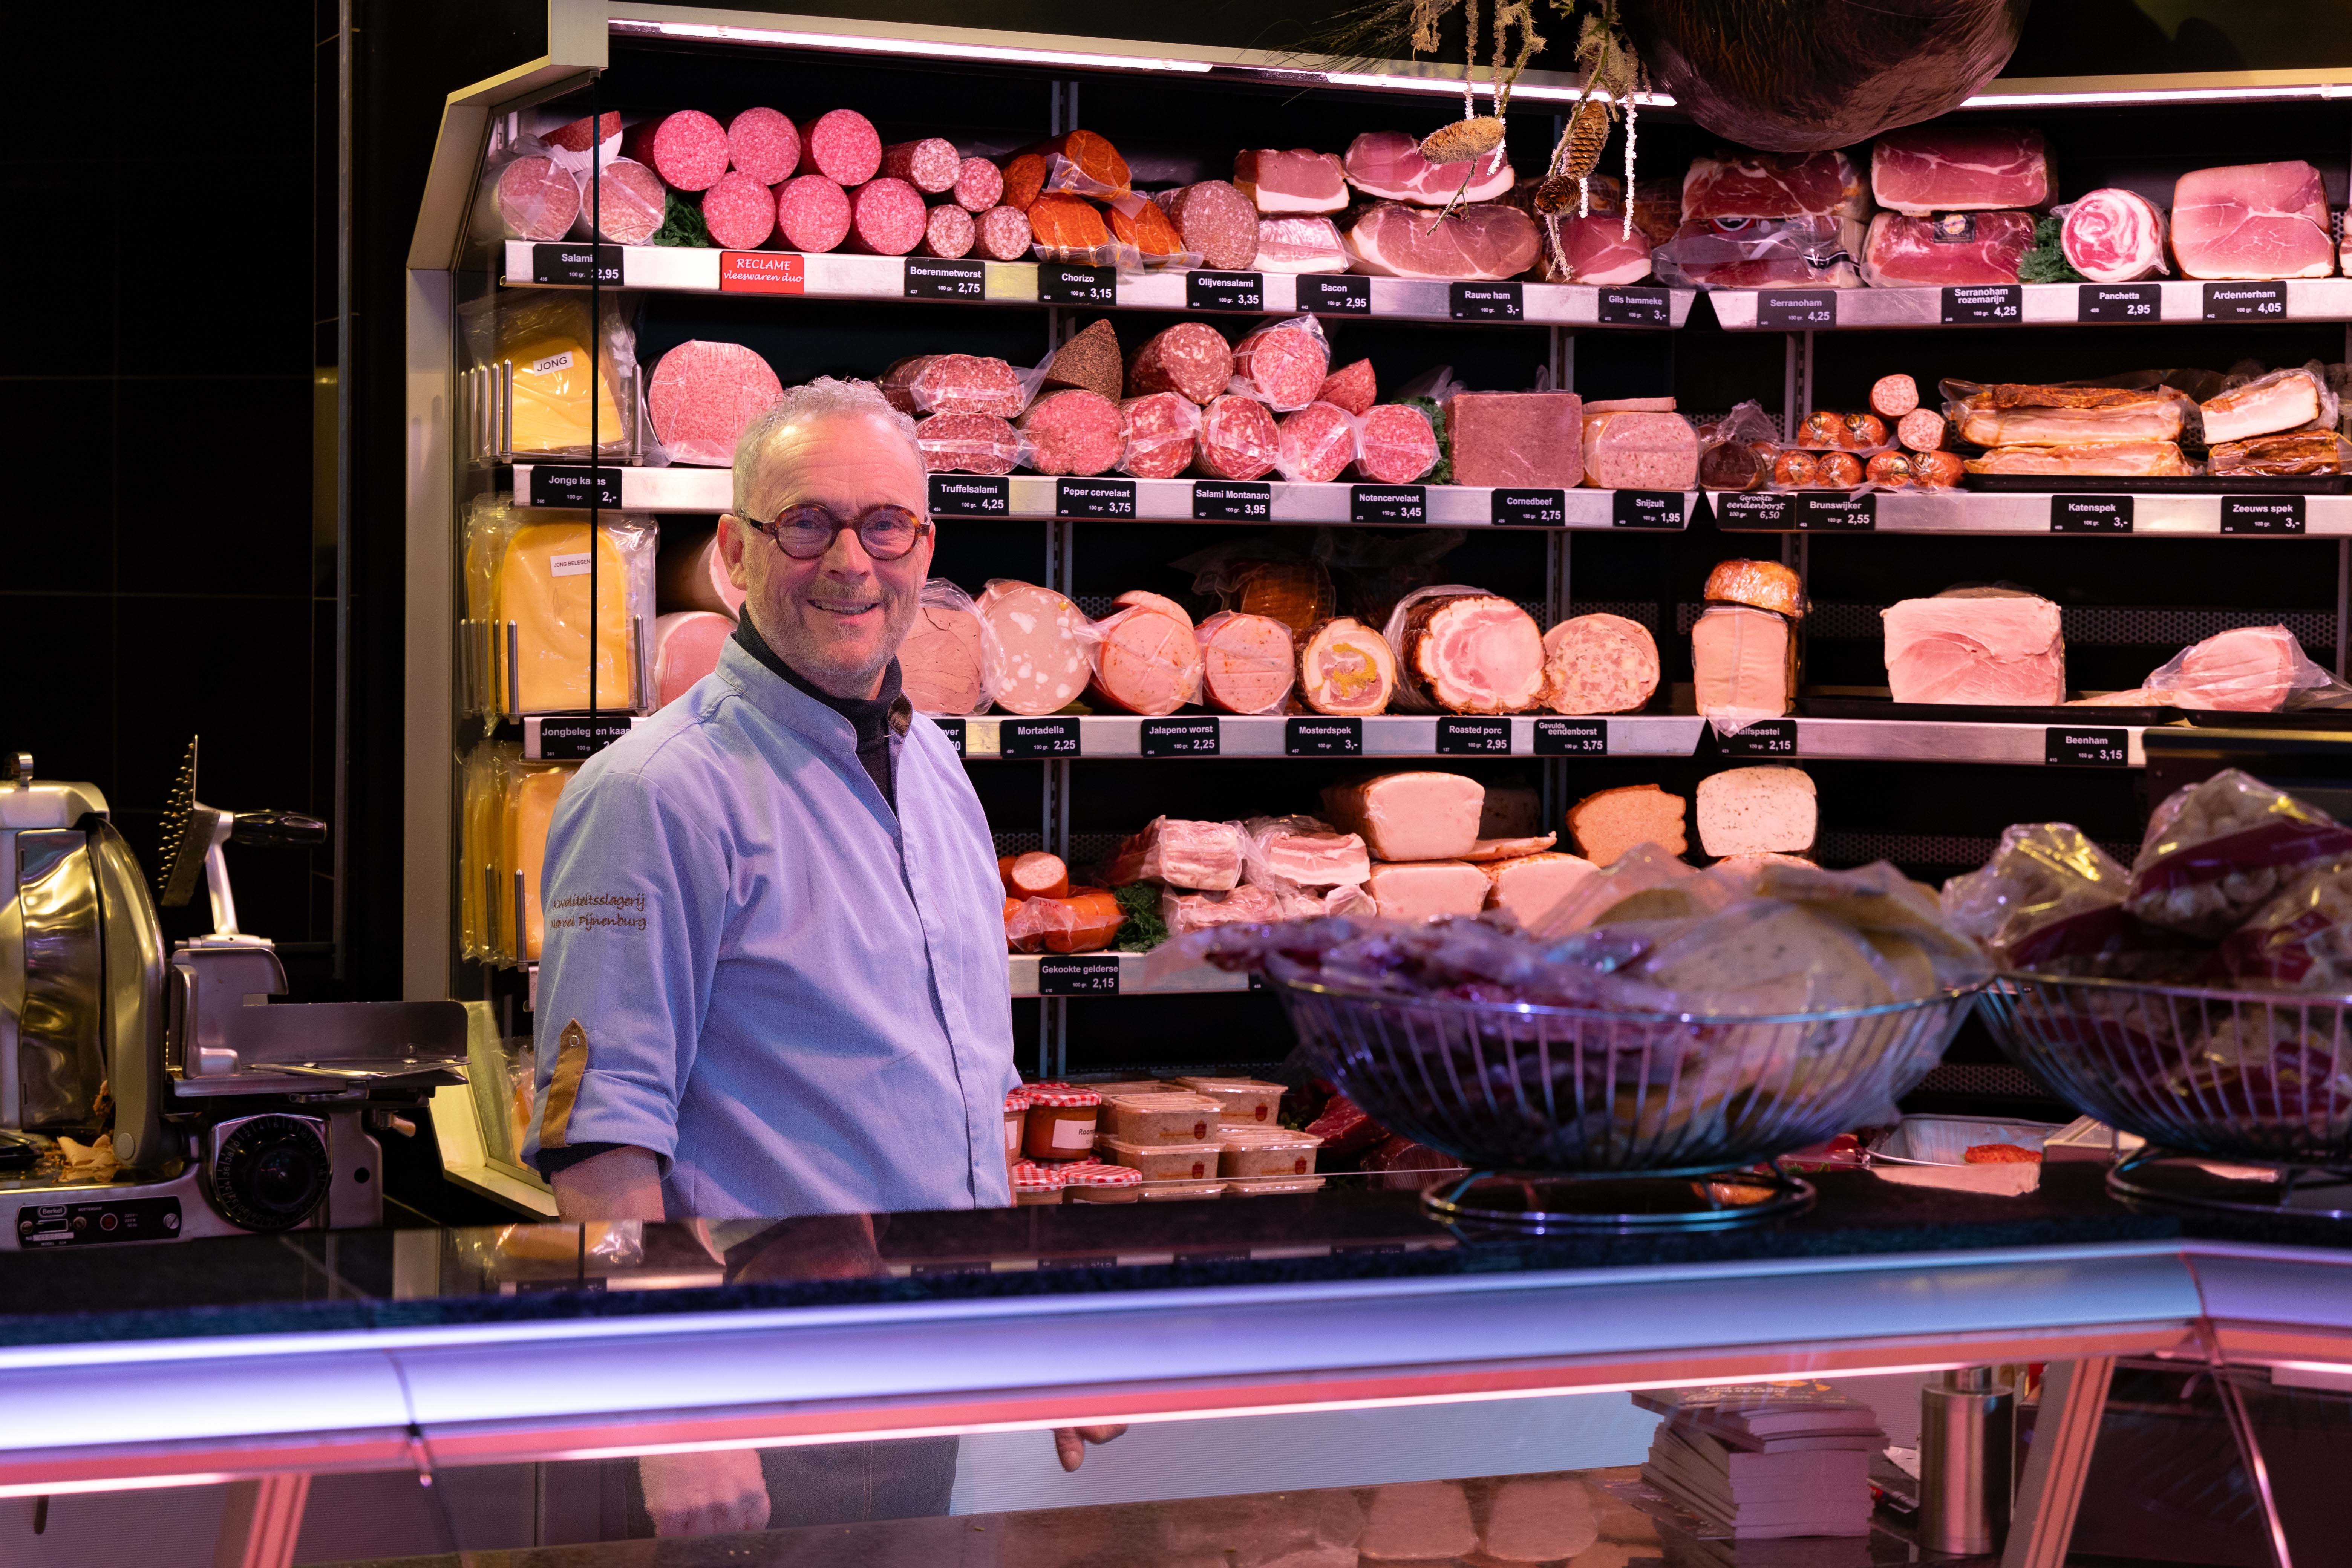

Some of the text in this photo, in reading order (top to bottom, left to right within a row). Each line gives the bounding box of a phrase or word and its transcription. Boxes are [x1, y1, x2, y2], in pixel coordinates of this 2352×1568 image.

[562, 254, 592, 262] Salami
[737, 259, 791, 271] RECLAME
[724, 271, 803, 282] vleeswaren duo
[910, 266, 981, 278] Boerenmetworst
[1062, 273, 1094, 282] Chorizo
[1198, 278, 1253, 288] Olijvensalami
[958, 283, 980, 294] 2,75
[1090, 288, 1112, 299] 3,15
[1955, 288, 2008, 296] Serranoham
[2213, 290, 2275, 299] Ardennerham
[1238, 295, 1259, 305] 3,35
[1346, 298, 1366, 308] 2,95
[1626, 296, 1662, 305] hammeke
[1507, 305, 1519, 315] 3,-
[1994, 306, 2017, 317] 4,25
[2127, 305, 2150, 315] 2,95
[2258, 303, 2281, 314] 4,05
[1654, 310, 1666, 320] 3,-
[1808, 312, 1830, 322] 4,25
[537, 356, 567, 372] JONG
[549, 476, 577, 486] Jonge
[941, 484, 997, 493] Truffelsalami
[1064, 487, 1089, 497] Peper
[603, 492, 616, 502] 2,-
[1226, 490, 1269, 499] Montanaro
[982, 499, 1004, 510] 4,25
[1109, 502, 1130, 513] 3,75
[1636, 499, 1664, 508] Snijzult
[1810, 501, 1862, 510] Brunswijker
[2069, 504, 2116, 513] Katenspek
[1245, 504, 1265, 515] 3,95
[1401, 507, 1421, 518] 3,45
[2271, 505, 2293, 514] spek
[1541, 510, 1561, 521] 2,75
[1661, 513, 1680, 523] 1,95
[1760, 511, 1779, 519] 6,50
[1848, 514, 1870, 525] 2,55
[2114, 517, 2128, 528] 3,-
[2286, 518, 2300, 528] 3,-
[1018, 726, 1064, 735] Mortadella
[1149, 727, 1187, 735] Jalapeno
[1299, 727, 1351, 735] Mosterdspek
[1054, 740, 1075, 751] 2,25
[1194, 740, 1214, 750] 2,25
[1345, 740, 1357, 750] 3,-
[1487, 740, 1507, 749] 2,95
[1583, 741, 1603, 750] 3,75
[1770, 740, 1790, 750] 2,15
[2100, 750, 2122, 760] 3,15
[1083, 965, 1118, 974] gelderse
[1093, 978, 1114, 988] 2,15
